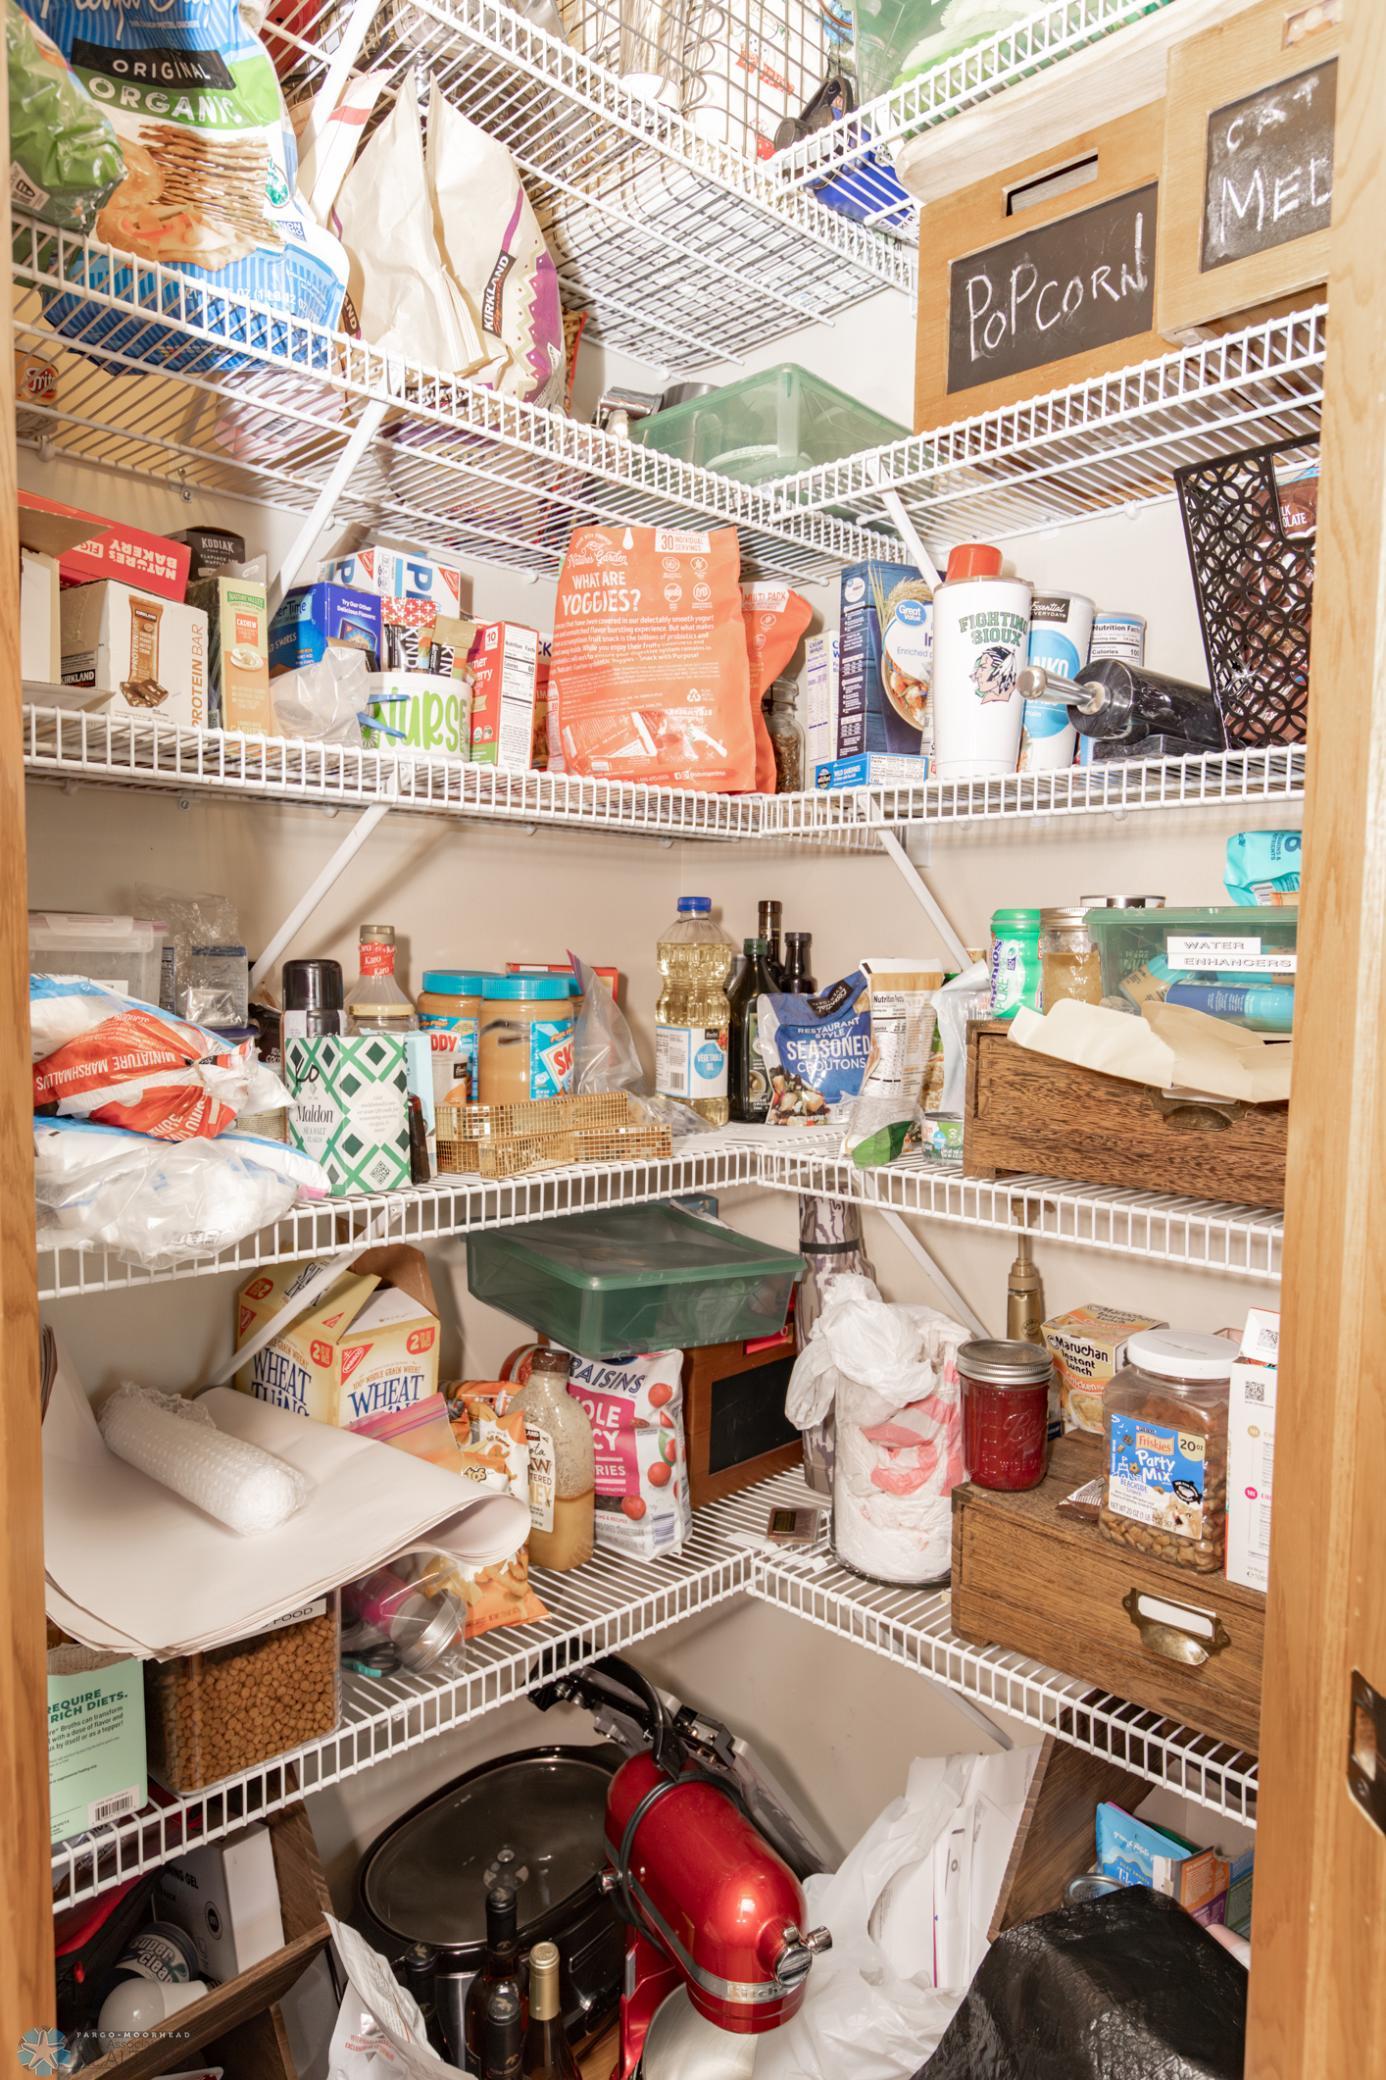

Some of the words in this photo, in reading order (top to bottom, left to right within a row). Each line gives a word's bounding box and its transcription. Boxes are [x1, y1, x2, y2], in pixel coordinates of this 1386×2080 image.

[112, 59, 211, 80] ORIGINAL
[88, 76, 243, 124] ORGANIC
[483, 255, 509, 332] KIRKLAND
[201, 537, 234, 553] KODIAK
[661, 535, 674, 550] 30
[109, 538, 178, 568] BAKERY
[108, 550, 177, 580] NATURE'S
[572, 573, 600, 590] WHAT
[602, 571, 626, 586] ARE
[562, 588, 641, 616] YOGGIES?
[767, 591, 786, 601] PACK
[287, 600, 307, 615] Time
[192, 624, 204, 656] BAR
[487, 631, 497, 643] 10
[971, 627, 1022, 647] SIOUX
[400, 626, 419, 669] KIND
[439, 643, 455, 678] KIN
[1183, 941, 1245, 950] WATER
[1183, 957, 1292, 968] ENHANCERS
[797, 1016, 860, 1034] RESTAURANT
[814, 1029, 845, 1038] STYLE
[786, 1035, 871, 1061] SEASONED
[112, 1051, 176, 1071] MINIATURE
[797, 1057, 867, 1073] CROUTONS
[296, 1104, 334, 1123] Maldon
[1055, 1335, 1109, 1362] Maruchan
[1061, 1349, 1096, 1369] Instant
[1066, 1359, 1093, 1377] Lunch
[252, 1347, 312, 1406] WHEAT
[568, 1356, 646, 1394] RAISINS
[347, 1374, 425, 1418] WHEAT
[585, 1398, 621, 1428] OLE
[1139, 1434, 1171, 1453] Friskies
[1180, 1439, 1196, 1452] 20
[593, 1465, 627, 1476] RIES
[1135, 1449, 1176, 1472] Party
[527, 1473, 552, 1486] TERED
[1142, 1467, 1172, 1484] Mix
[273, 1606, 313, 1626] FOOD
[50, 1706, 82, 1723] RICH
[87, 1690, 128, 1711] DIETS.
[52, 1732, 66, 1743] with
[71, 1726, 86, 1737] dose
[112, 1713, 124, 1722] and
[60, 1719, 81, 1732] Broths
[82, 1717, 93, 1726] can
[93, 1706, 123, 1721] transform
[56, 1741, 64, 1751] by
[65, 1735, 82, 1746] itself
[88, 1730, 97, 1739] as
[184, 1871, 199, 1889] GEL
[131, 1937, 176, 1961] Super
